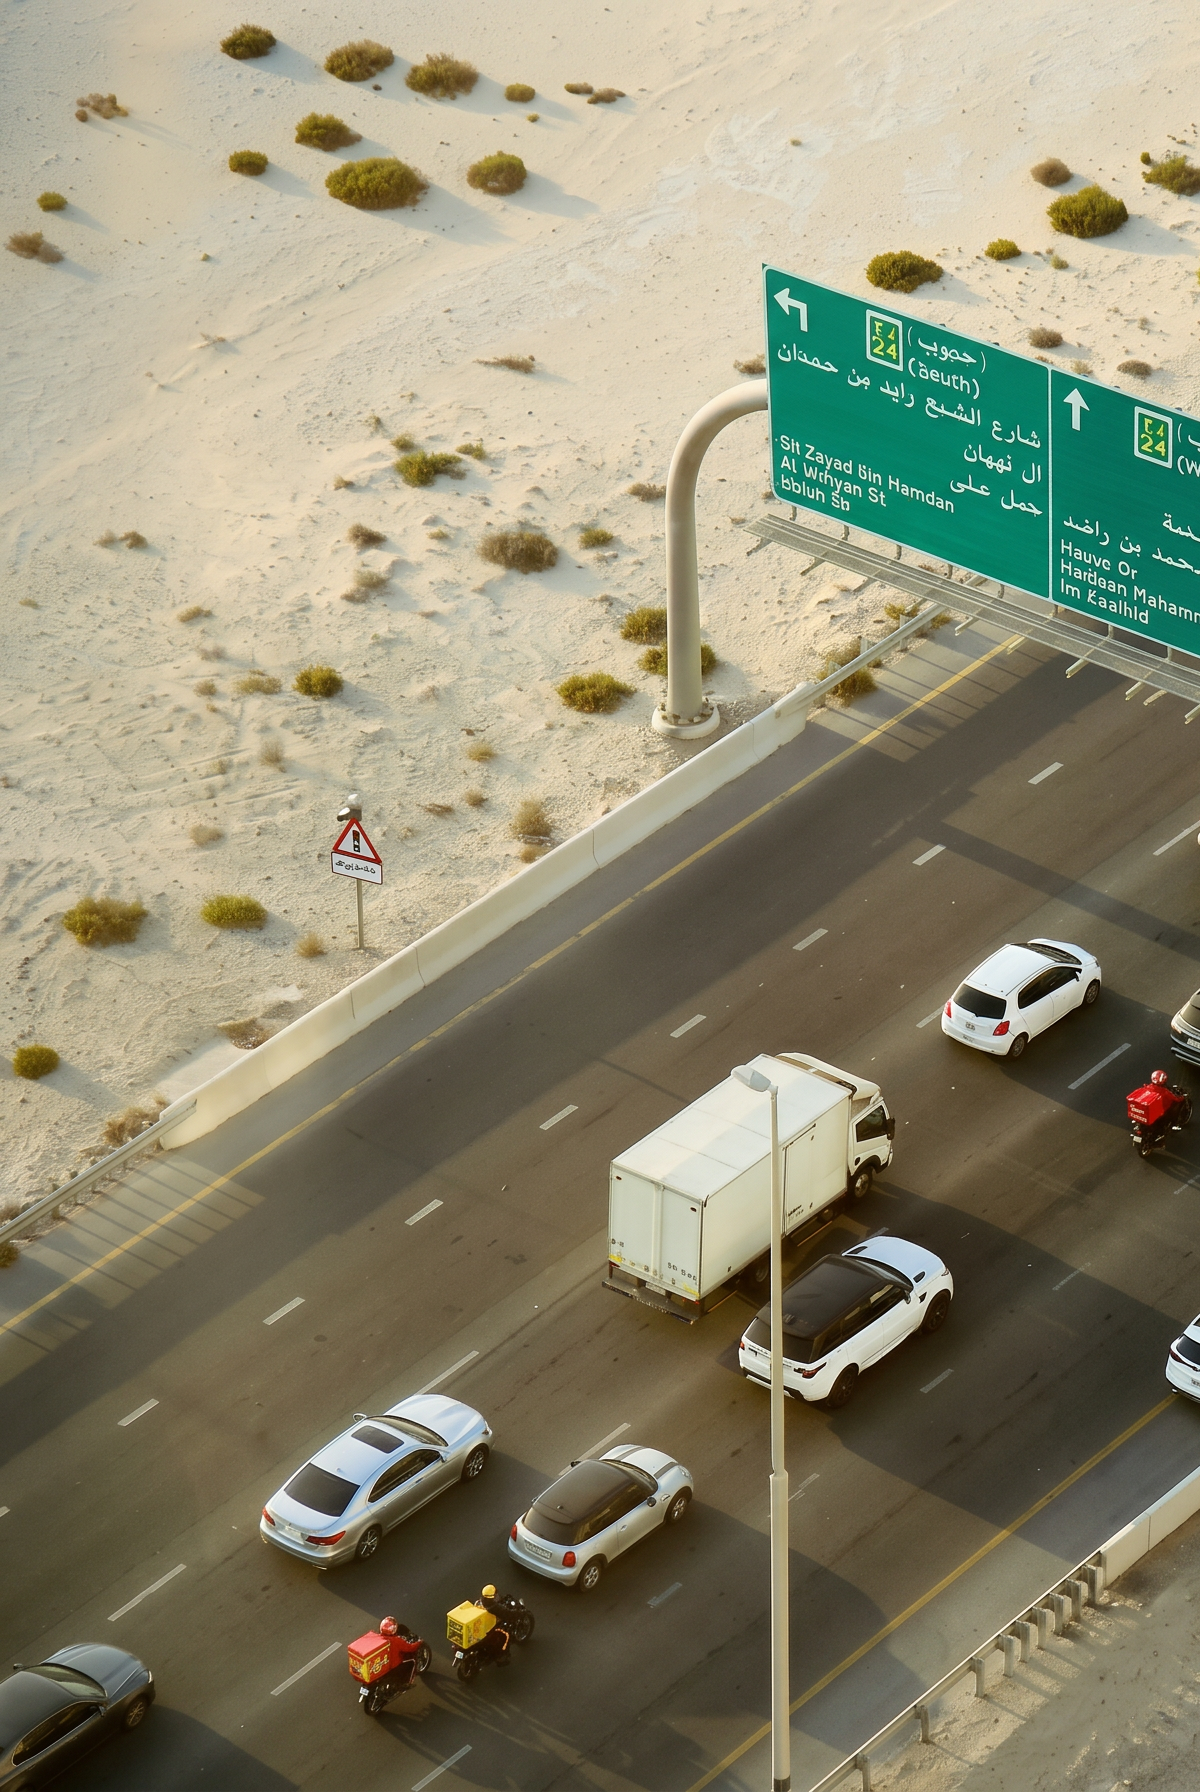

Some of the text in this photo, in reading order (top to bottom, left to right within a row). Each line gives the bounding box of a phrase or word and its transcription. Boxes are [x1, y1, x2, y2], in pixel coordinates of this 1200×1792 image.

[871, 335, 898, 360] 24
[1140, 433, 1166, 457] 24
[780, 455, 797, 474] Al
[868, 486, 887, 507] St
[804, 443, 853, 475] Zayad
[888, 474, 954, 514] Hamdan
[1118, 560, 1138, 580] Or
